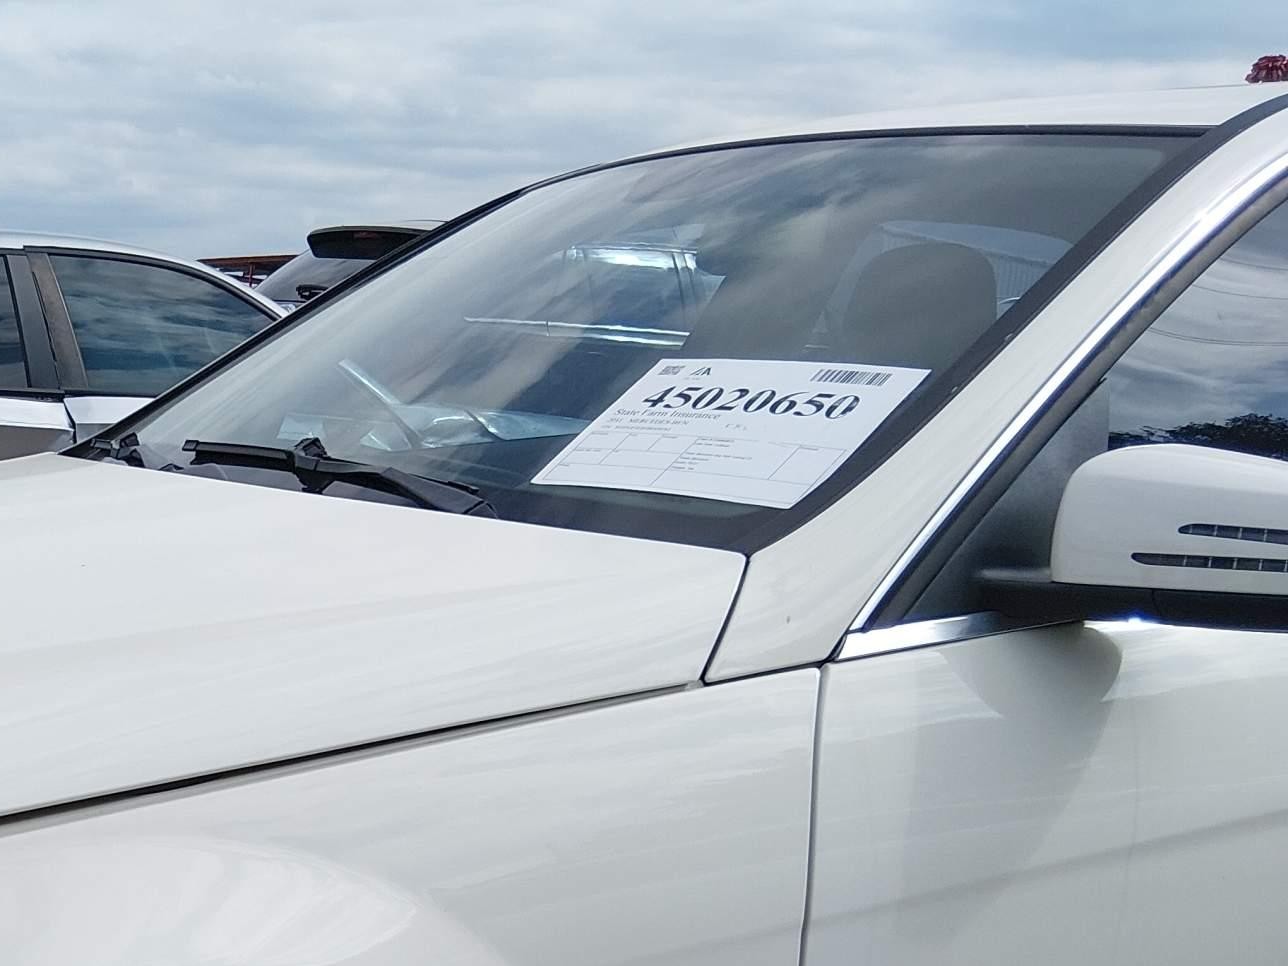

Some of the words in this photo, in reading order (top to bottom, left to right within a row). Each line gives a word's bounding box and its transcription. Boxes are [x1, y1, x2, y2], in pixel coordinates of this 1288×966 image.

[615, 408, 640, 416] State
[640, 409, 667, 417] Farm
[669, 410, 721, 420] Insurance
[641, 385, 861, 420] 45020650
